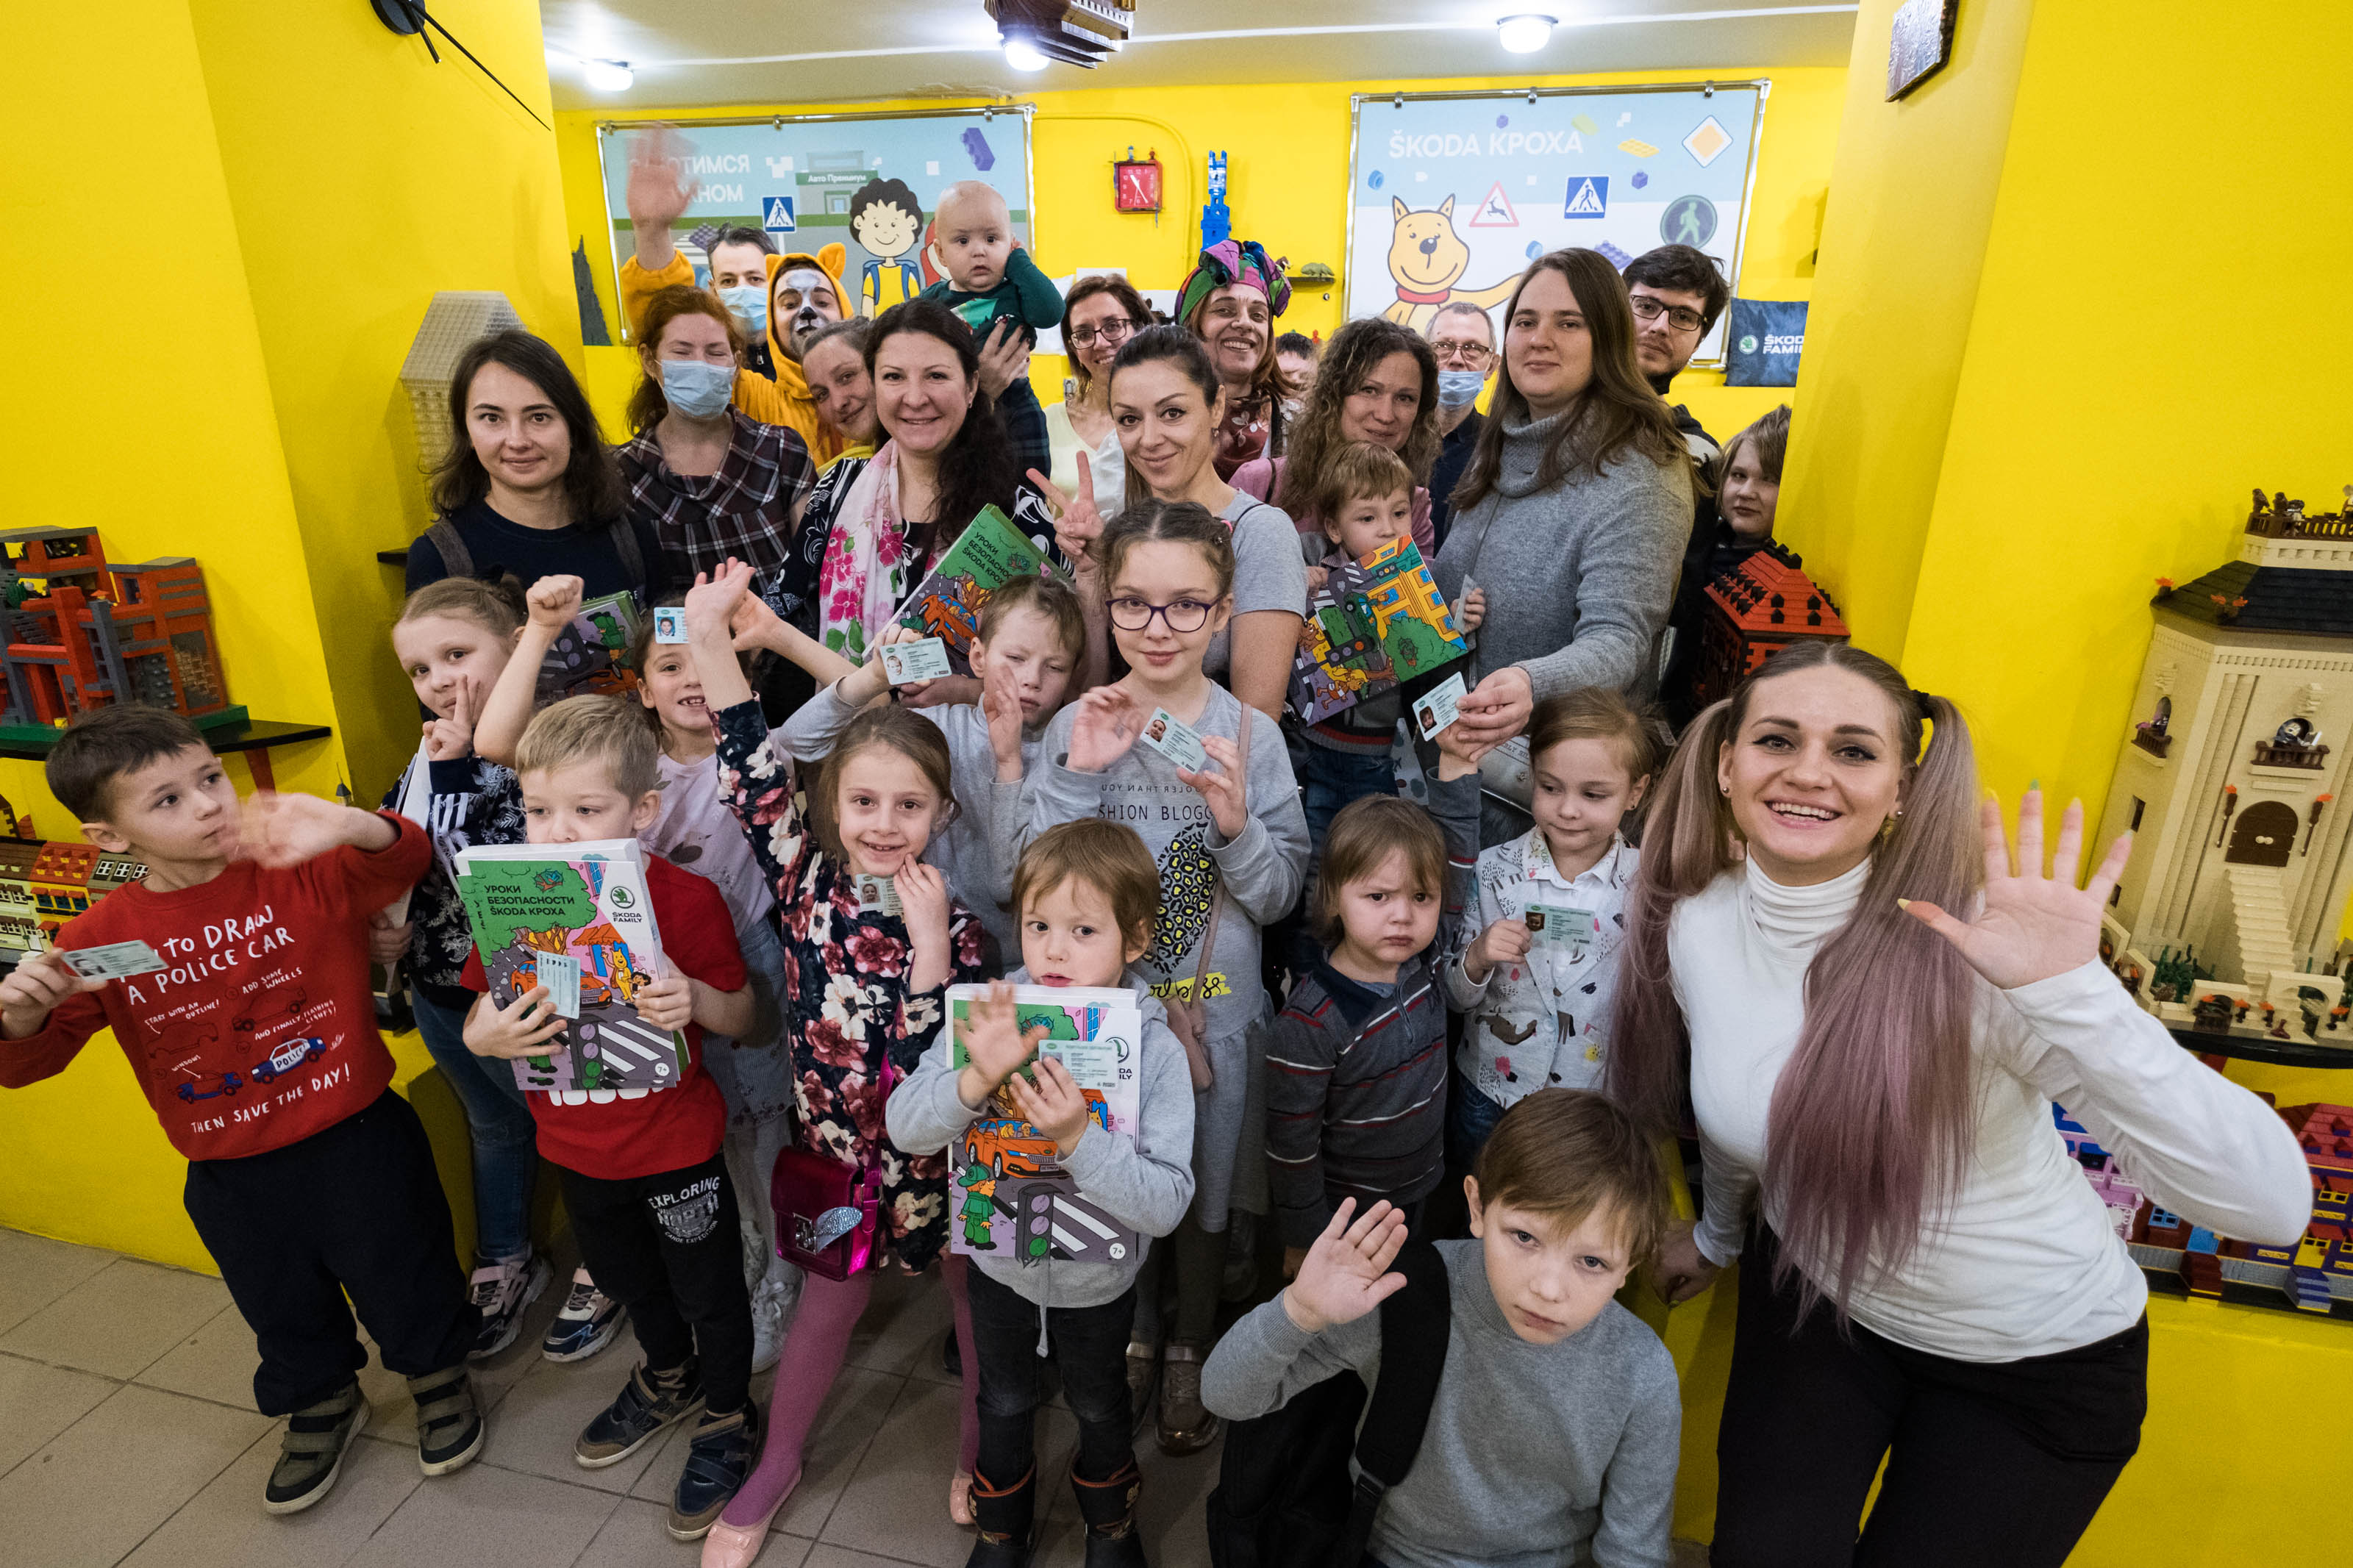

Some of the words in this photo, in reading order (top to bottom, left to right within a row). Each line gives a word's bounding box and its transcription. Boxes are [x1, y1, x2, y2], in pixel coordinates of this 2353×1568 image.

[1388, 129, 1481, 159] ŠKODA
[630, 154, 751, 176] ОТИМСЯ
[1763, 345, 1802, 354] FAMI
[1764, 334, 1804, 345] ŠKOD
[974, 531, 999, 556] УРОКИ
[962, 546, 986, 570] ŠKODA
[985, 567, 1004, 584] КРОХ
[1099, 804, 1148, 820] SHION
[1161, 805, 1213, 821] BLOGG
[484, 884, 521, 894] УРОКИ
[488, 896, 575, 905] БЕЗОПАСНОСТИ
[490, 906, 526, 916] ŠKODA
[529, 907, 565, 916] КРОХА
[203, 905, 274, 949] DRAW
[128, 984, 147, 1006] A
[247, 927, 296, 959] CAR
[242, 981, 258, 995] ADD
[261, 968, 282, 985] SOME
[265, 967, 303, 989] WHEELS
[185, 999, 220, 1020] OUTLINE!
[254, 1029, 271, 1041] AND
[191, 1116, 225, 1134] THEN
[234, 1101, 270, 1123] SAVE
[276, 1085, 304, 1106] THE
[648, 1176, 720, 1209] EXPLORING
